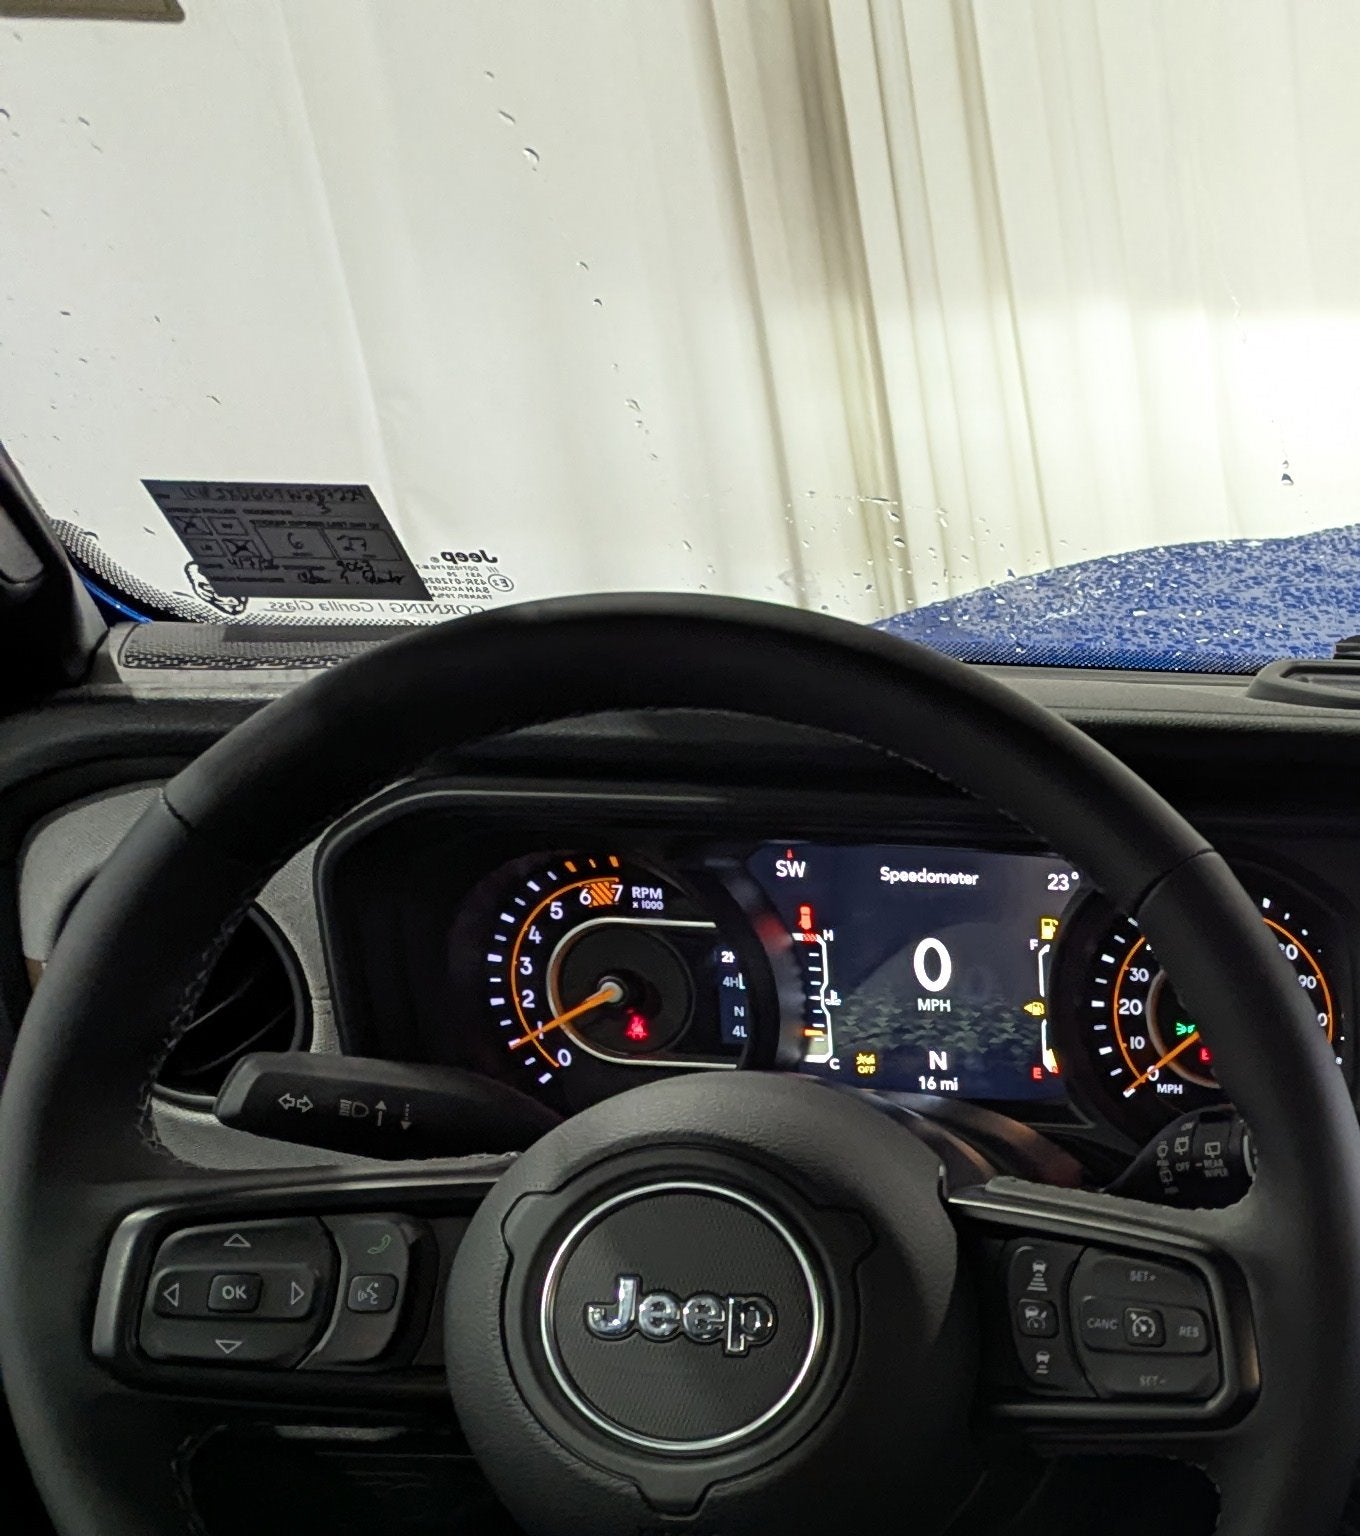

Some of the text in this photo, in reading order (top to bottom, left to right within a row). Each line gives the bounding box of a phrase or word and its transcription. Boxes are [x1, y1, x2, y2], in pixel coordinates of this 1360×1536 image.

[775, 860, 806, 878] SW
[880, 866, 979, 886] Speedometer
[579, 885, 623, 905] 6 7
[631, 886, 662, 900] RPM
[550, 902, 563, 919] 5
[641, 900, 664, 910] 1000
[528, 925, 541, 944] 4
[823, 929, 834, 941] H
[1029, 939, 1038, 950] F
[520, 957, 532, 975] 3
[913, 937, 951, 992] 0
[1129, 967, 1149, 982] 30
[521, 990, 535, 1008] 2
[917, 998, 951, 1012] MPH
[734, 1006, 744, 1017] N
[1119, 999, 1143, 1015] 20
[732, 1026, 748, 1038] 4L
[1130, 1036, 1145, 1049] 10
[557, 1049, 572, 1066] 0
[829, 1058, 840, 1070] C
[928, 1051, 948, 1070] N
[1032, 1067, 1043, 1079] E
[918, 1076, 958, 1091] 16 mi
[1157, 1083, 1183, 1095] MPH
[222, 1285, 247, 1301] OK
[585, 1274, 778, 1357] Jeep
[1086, 1318, 1118, 1330] CANC
[1179, 1326, 1200, 1338] RES
